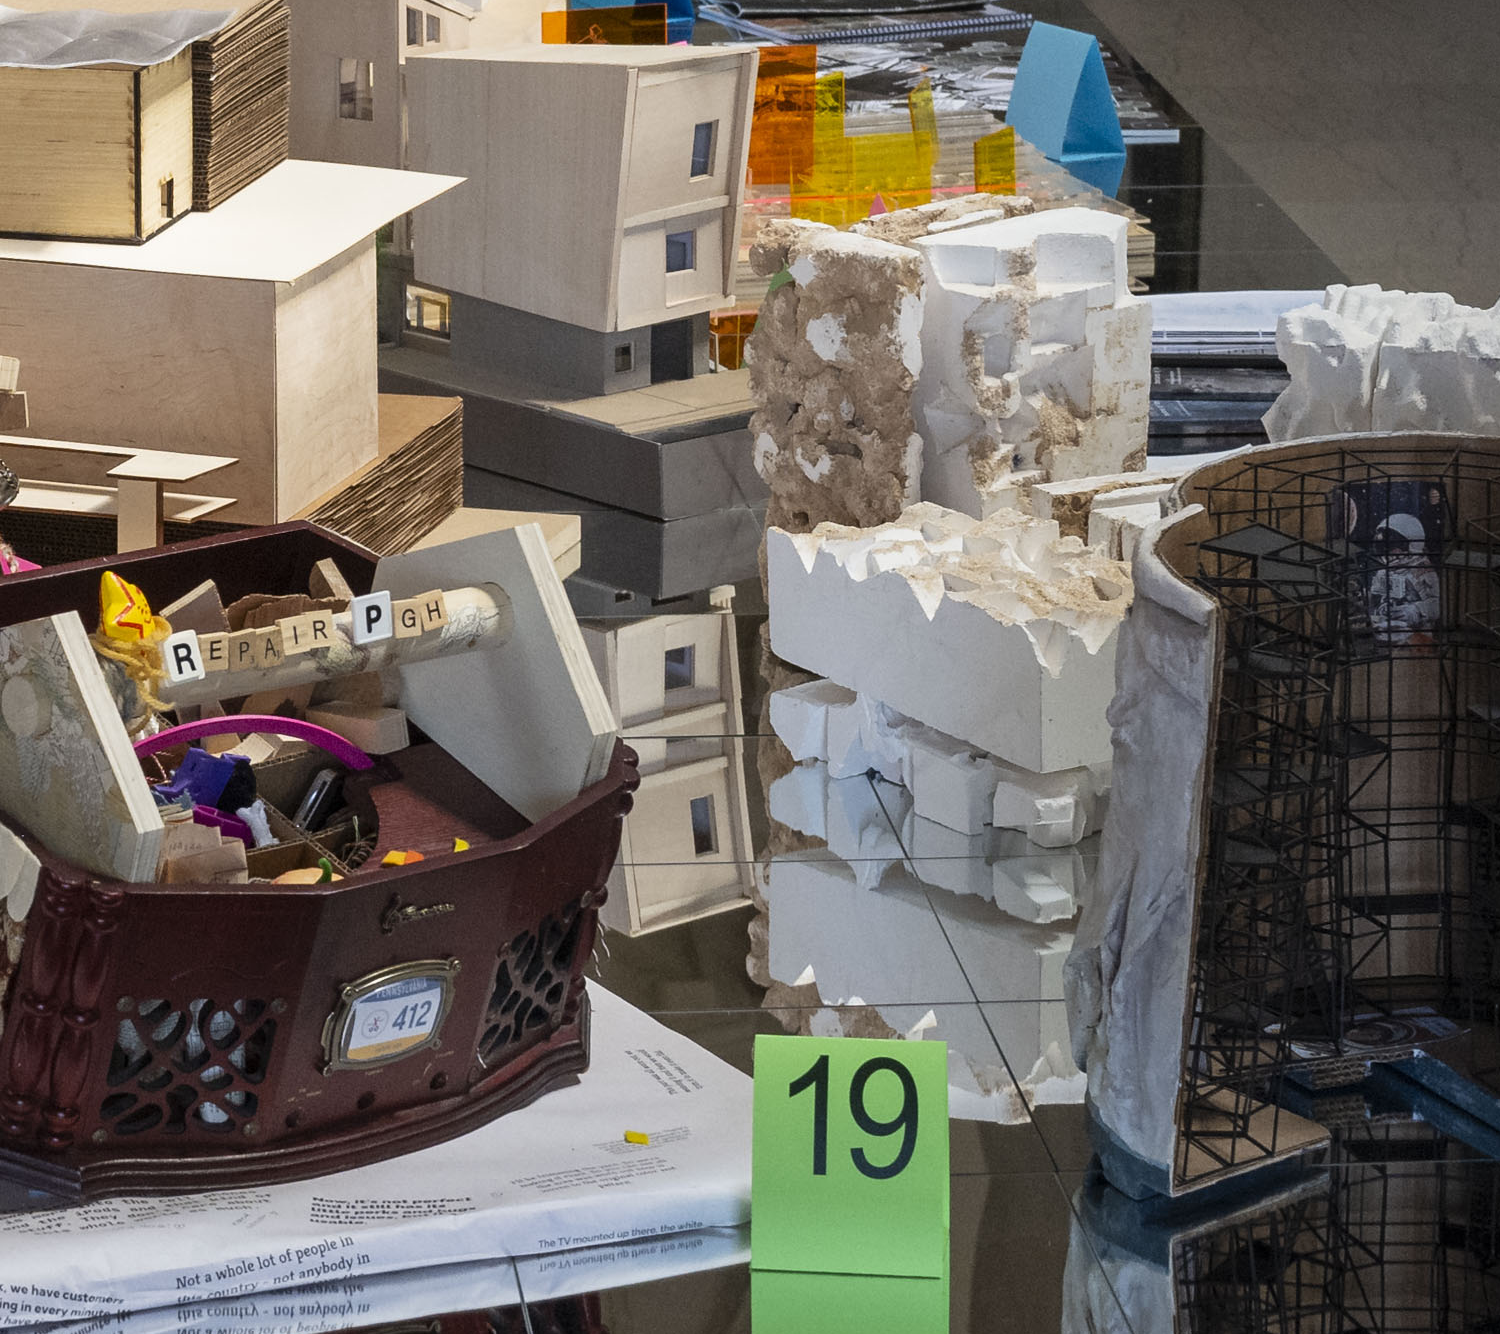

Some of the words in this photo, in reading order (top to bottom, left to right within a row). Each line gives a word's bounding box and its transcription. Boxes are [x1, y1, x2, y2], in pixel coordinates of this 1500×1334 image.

[173, 619, 328, 675] REPAIR
[365, 600, 442, 634] PGH
[392, 1000, 433, 1031] 412
[789, 1055, 918, 1179] 19
[539, 1238, 556, 1249] The
[558, 1237, 571, 1246] TV
[573, 1231, 615, 1244] mounted
[616, 1229, 629, 1240] up
[660, 1223, 676, 1233] the
[677, 1220, 703, 1230] white
[176, 1275, 200, 1290] Not
[204, 1273, 212, 1283] a
[215, 1261, 255, 1281] whole
[258, 1254, 276, 1269] lot
[279, 1249, 292, 1264] of
[295, 1238, 338, 1260] people
[341, 1235, 354, 1247] in
[206, 1281, 258, 1301] country
[273, 1271, 296, 1285] not
[299, 1256, 354, 1279] anybody
[357, 1252, 371, 1265] in
[10, 1285, 29, 1296] we
[31, 1284, 61, 1299] have
[63, 1290, 125, 1305] customers
[21, 1299, 34, 1312] in
[35, 1306, 69, 1318] every
